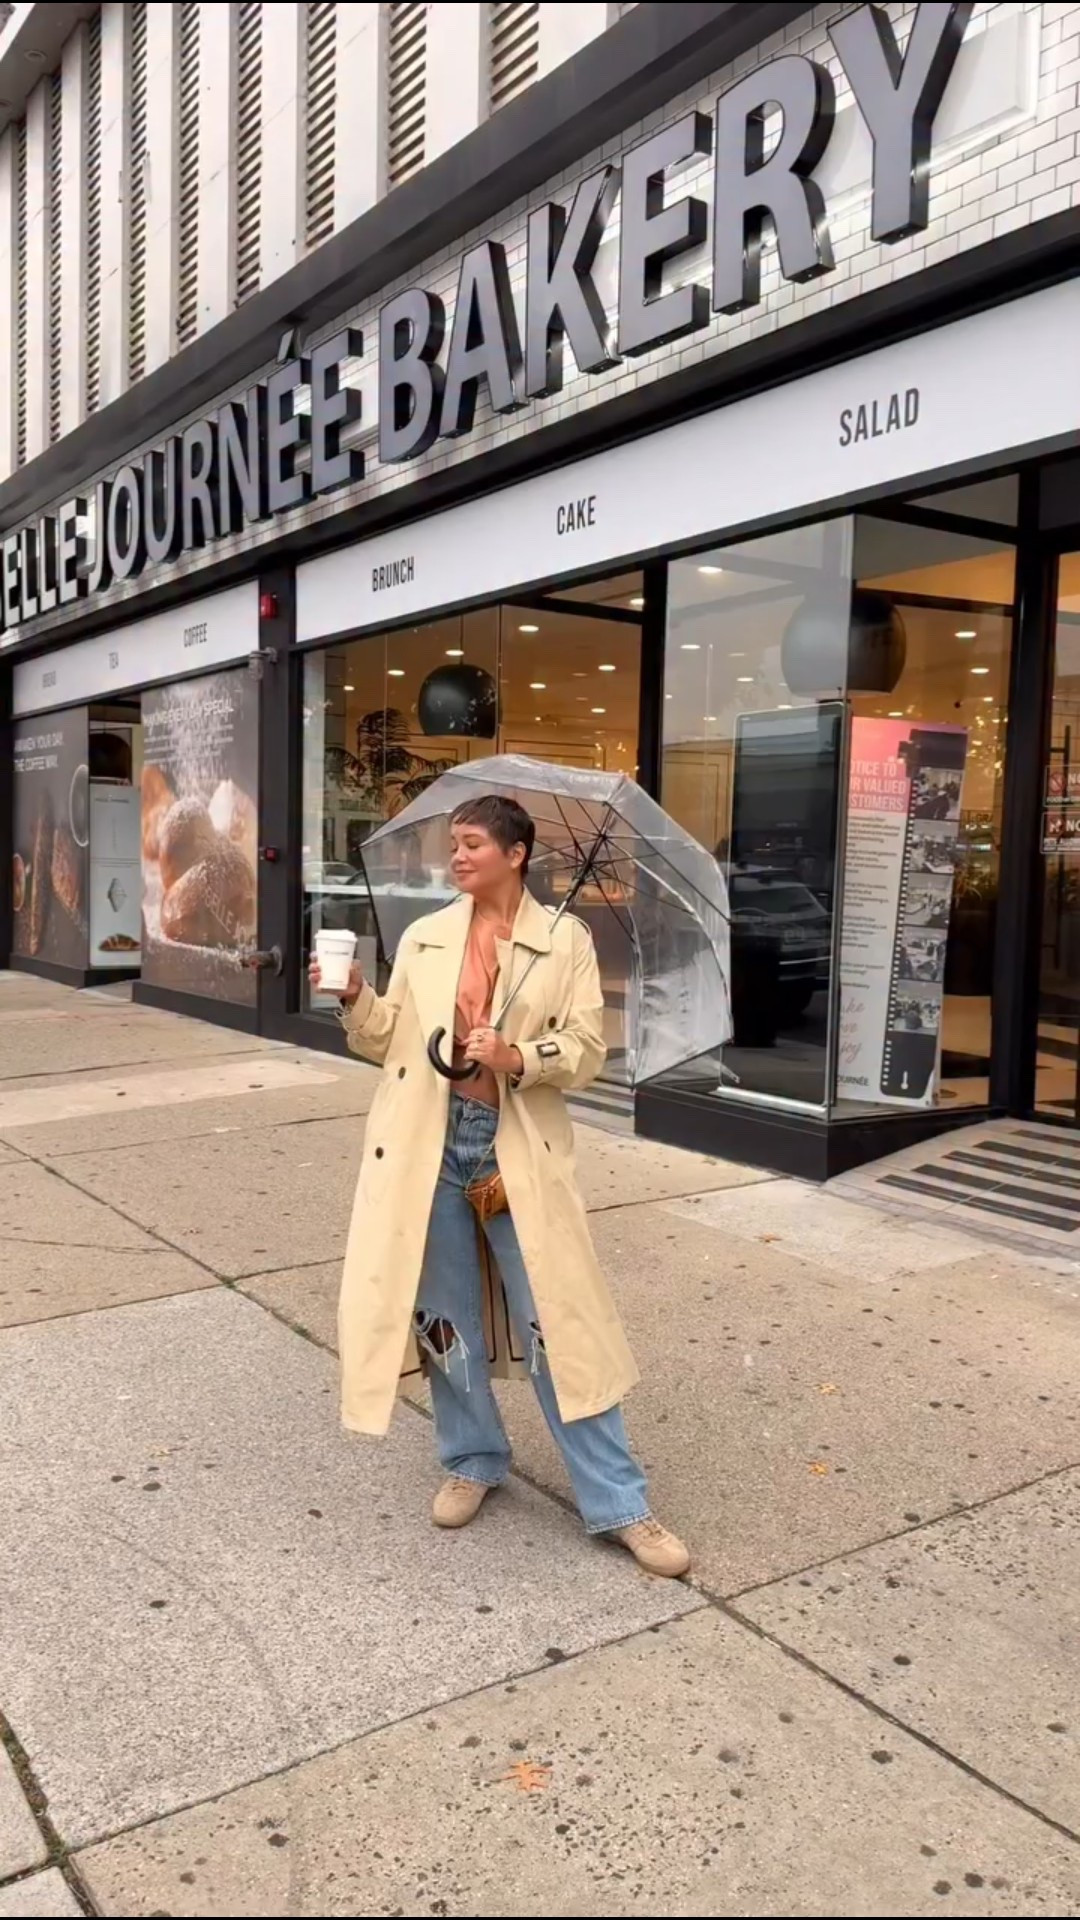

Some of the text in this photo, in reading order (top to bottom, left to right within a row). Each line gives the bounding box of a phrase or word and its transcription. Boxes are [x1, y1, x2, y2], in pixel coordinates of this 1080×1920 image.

[87, 328, 365, 592] JOURNÉE
[378, 2, 975, 463] BAKERY
[839, 388, 920, 447] SALAD
[556, 495, 597, 536] CAKE
[371, 556, 415, 593] BRUNCH
[184, 623, 208, 648] COFFEE
[863, 780, 906, 795] VALUED
[883, 764, 898, 777] TO
